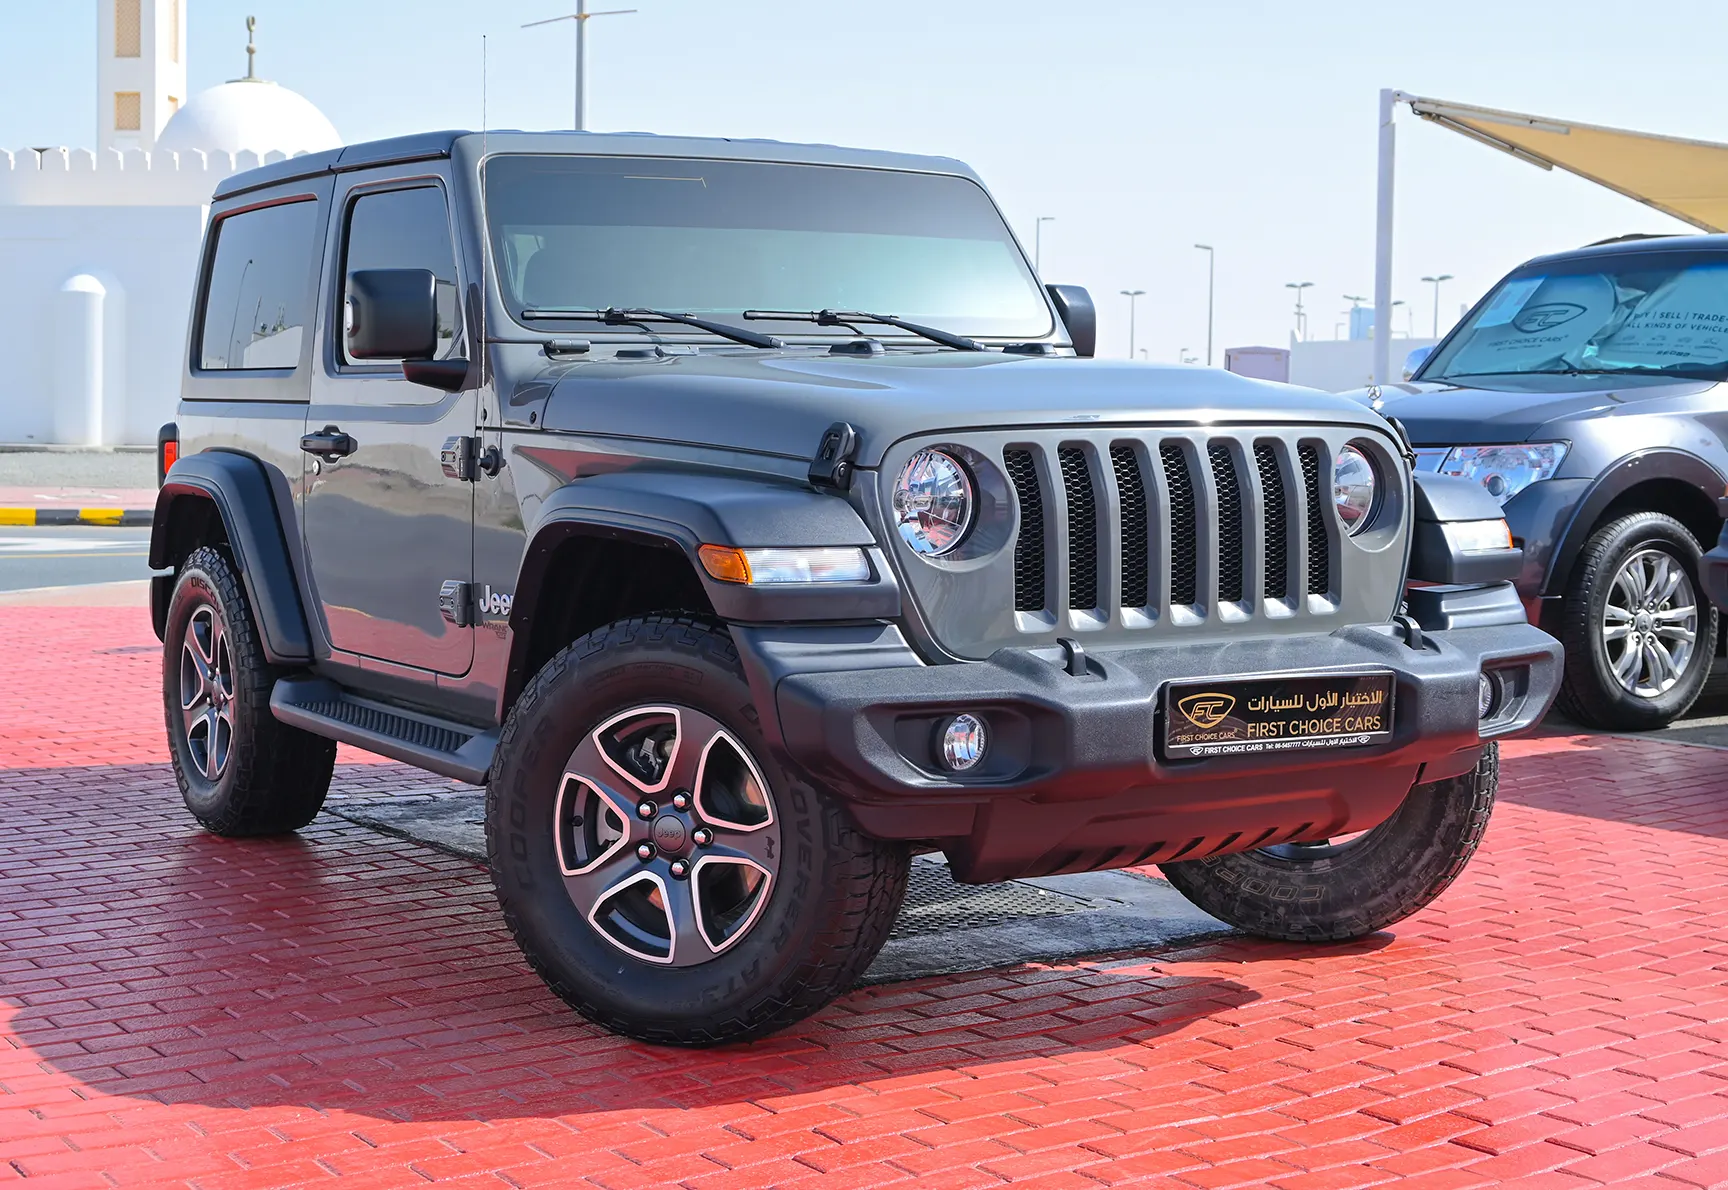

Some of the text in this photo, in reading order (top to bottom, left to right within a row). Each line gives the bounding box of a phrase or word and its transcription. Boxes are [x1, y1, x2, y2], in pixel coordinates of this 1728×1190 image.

[479, 584, 513, 615] Jee
[1248, 691, 1382, 713] الاختيار الأول للسيارات
[1219, 731, 1235, 739] CARS
[1247, 716, 1381, 738] FIRST CHOICE CARS
[1204, 746, 1221, 754] FIRST
[1222, 745, 1246, 753] CHOICE
[1246, 743, 1263, 751] CARS
[658, 828, 681, 840] Jeep
